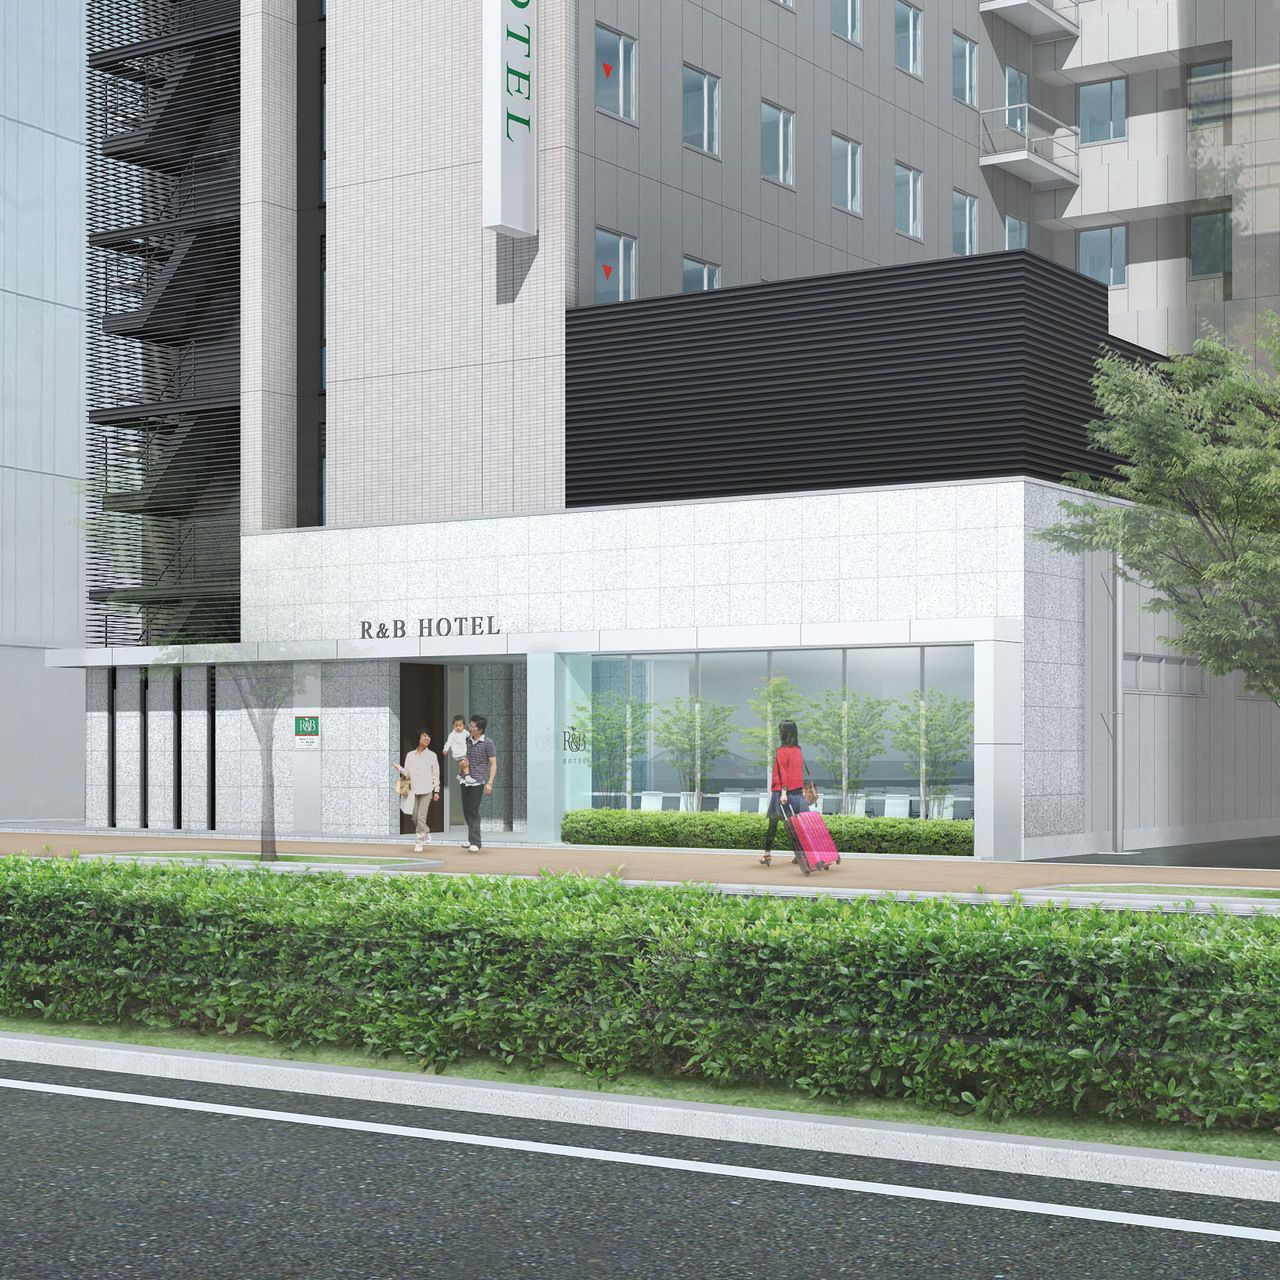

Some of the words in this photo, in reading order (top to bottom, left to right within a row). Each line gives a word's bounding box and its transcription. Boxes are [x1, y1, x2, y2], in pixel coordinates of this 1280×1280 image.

[360, 619, 406, 639] R&B
[418, 615, 500, 637] HOTEL
[562, 730, 586, 752] R&B
